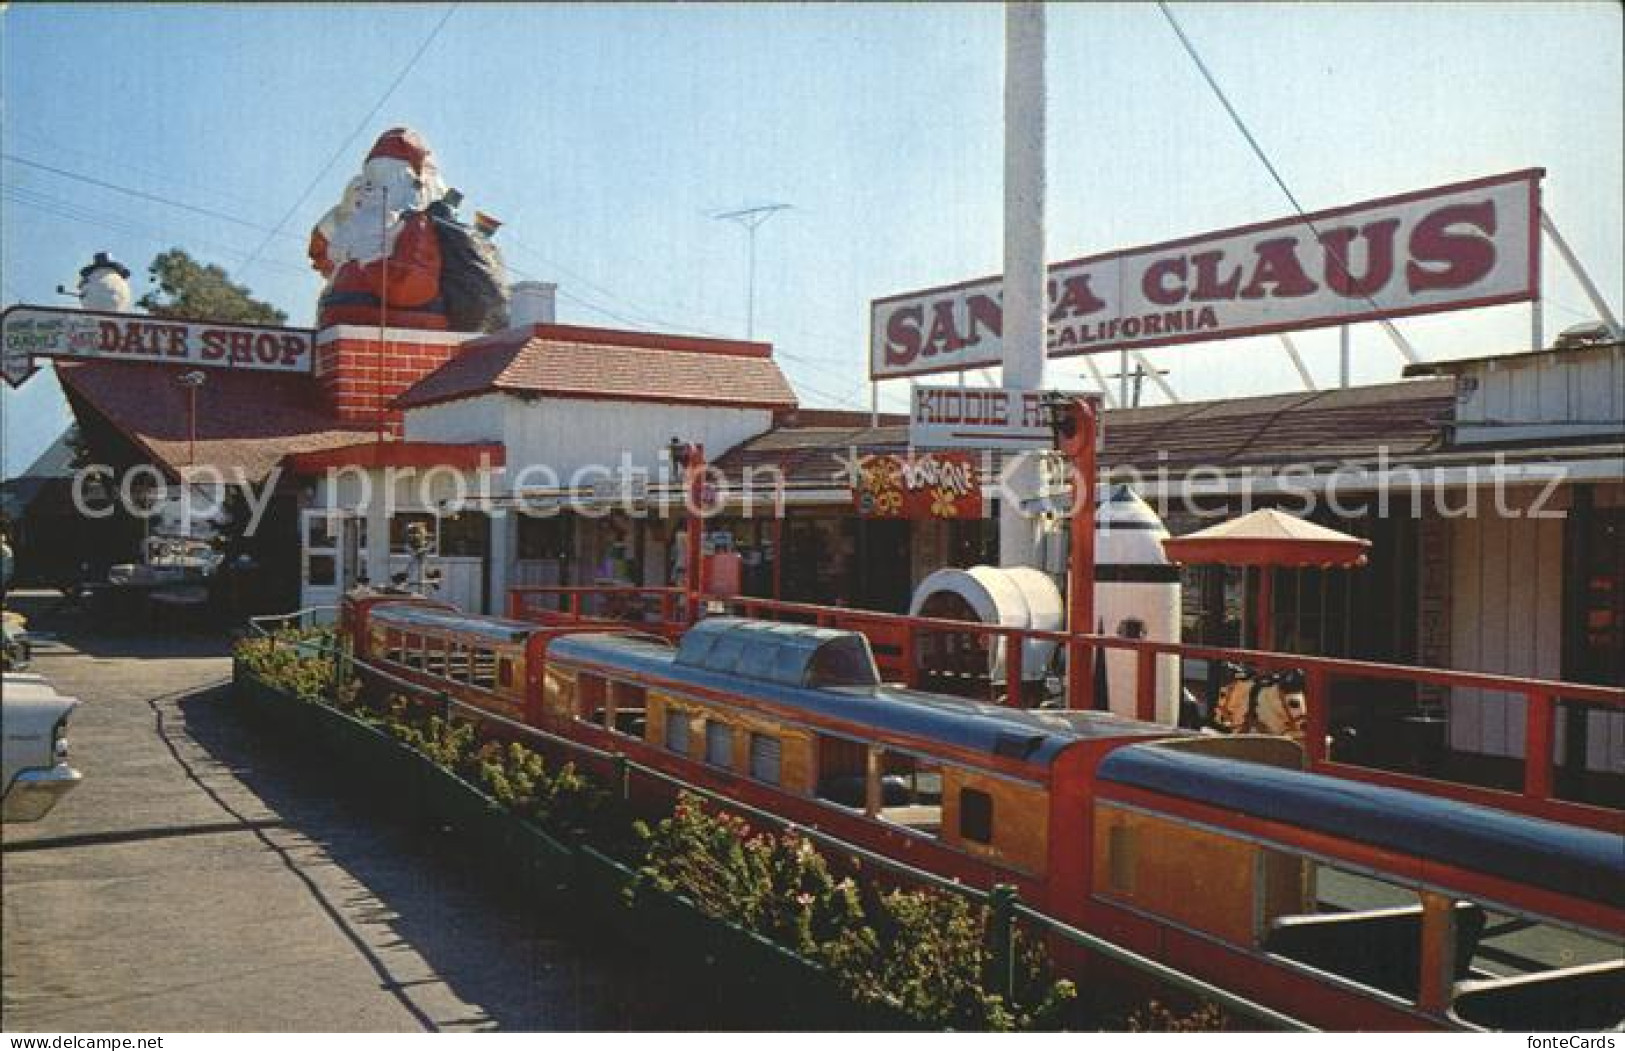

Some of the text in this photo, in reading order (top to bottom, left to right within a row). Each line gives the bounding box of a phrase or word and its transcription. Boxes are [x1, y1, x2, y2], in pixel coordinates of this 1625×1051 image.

[885, 199, 1496, 367] SANA CLAUS
[98, 321, 189, 358] DATE
[200, 329, 305, 365] SHOP
[917, 389, 1009, 426] KIDDIE
